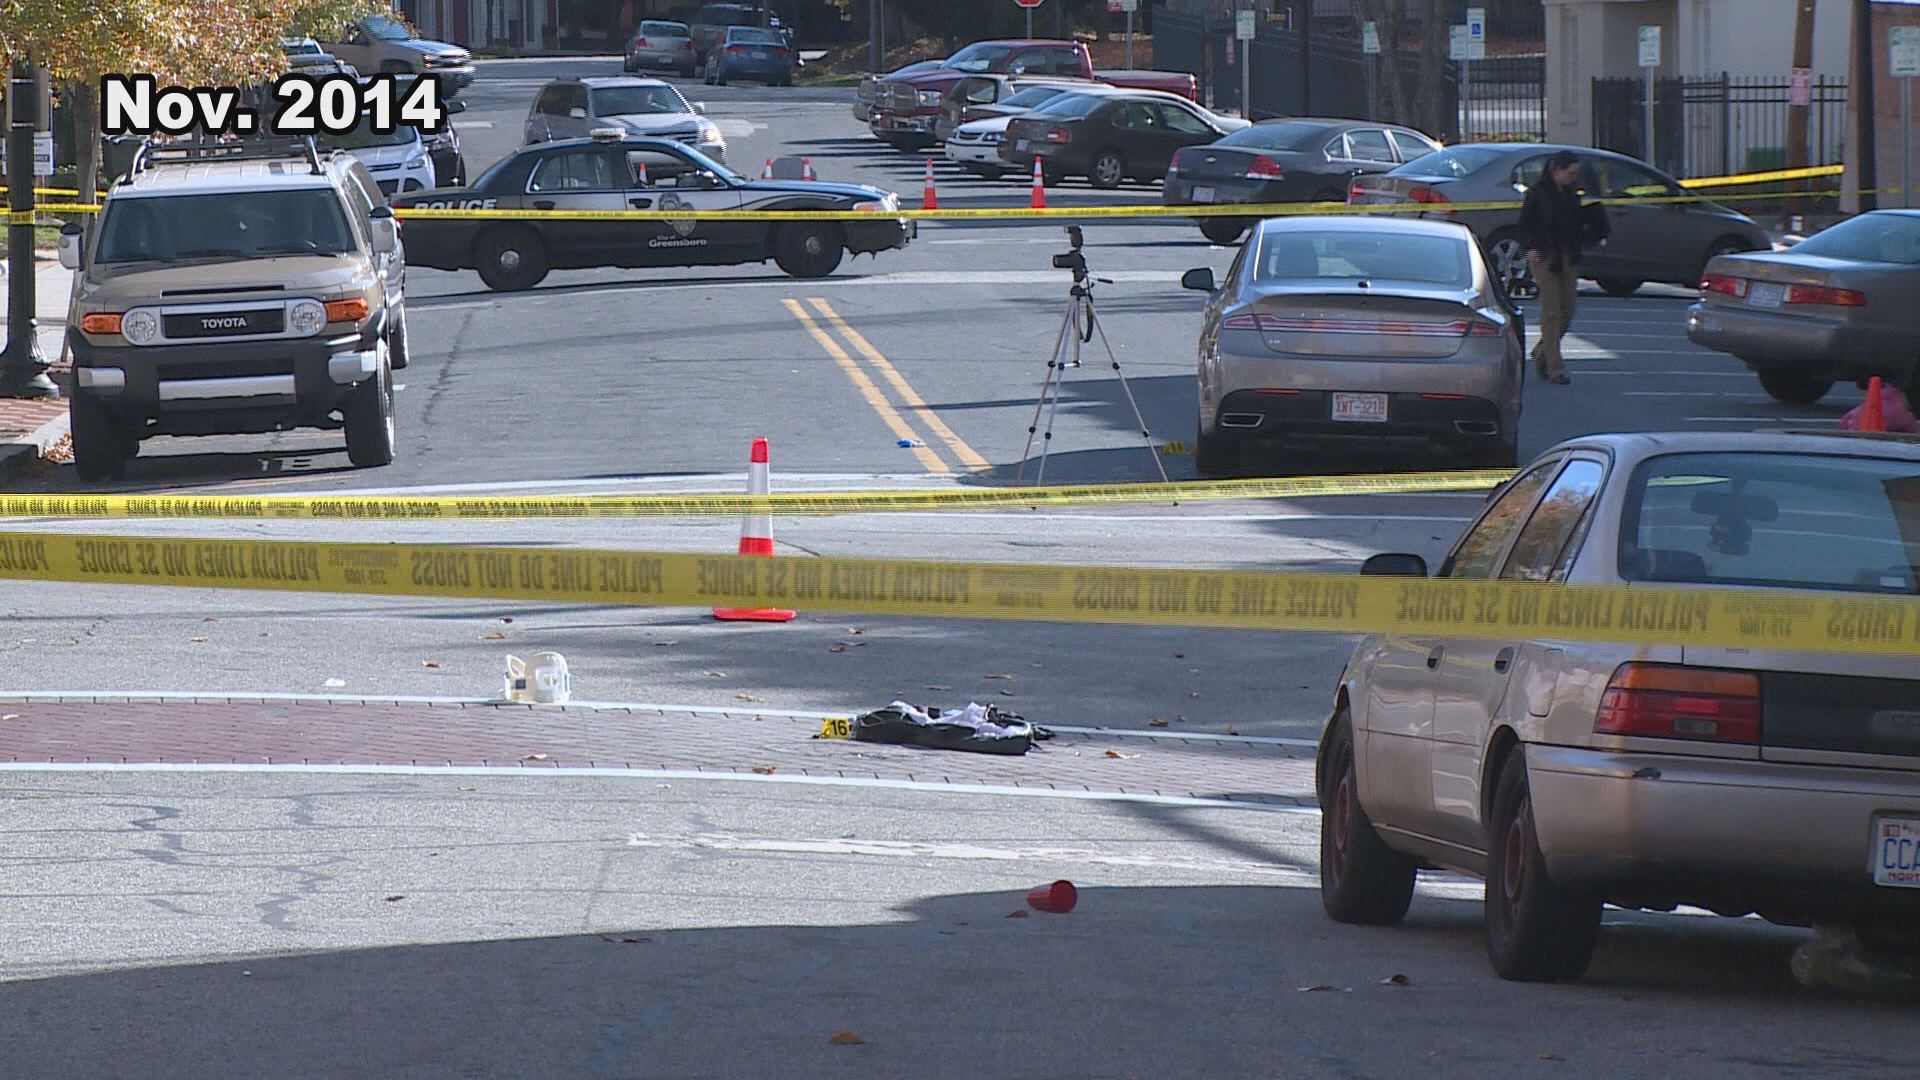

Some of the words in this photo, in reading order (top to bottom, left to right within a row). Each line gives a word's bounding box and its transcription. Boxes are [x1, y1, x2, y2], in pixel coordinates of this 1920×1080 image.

[648, 239, 708, 248] Greensboro
[201, 317, 247, 329] TOYOTA
[830, 719, 848, 736] 16
